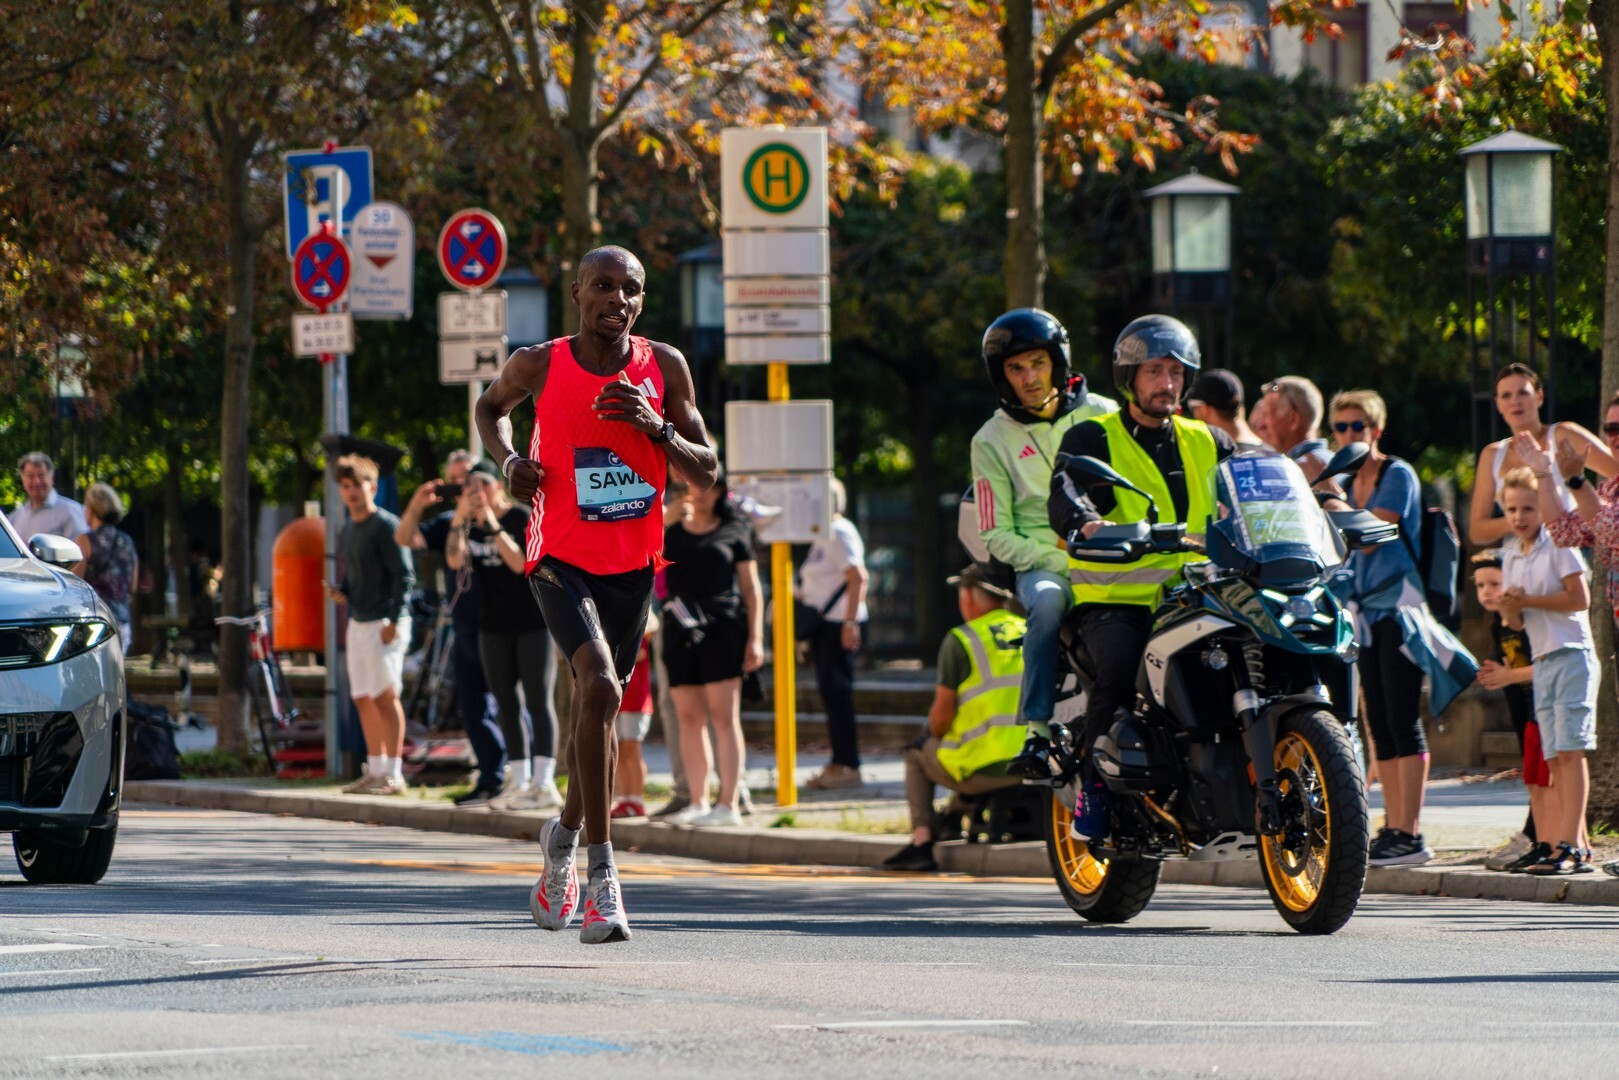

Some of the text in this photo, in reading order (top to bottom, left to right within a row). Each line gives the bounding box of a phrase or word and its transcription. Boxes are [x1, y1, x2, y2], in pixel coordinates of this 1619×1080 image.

[764, 159, 791, 198] H
[1239, 477, 1256, 488] 25
[601, 500, 645, 514] zalando
